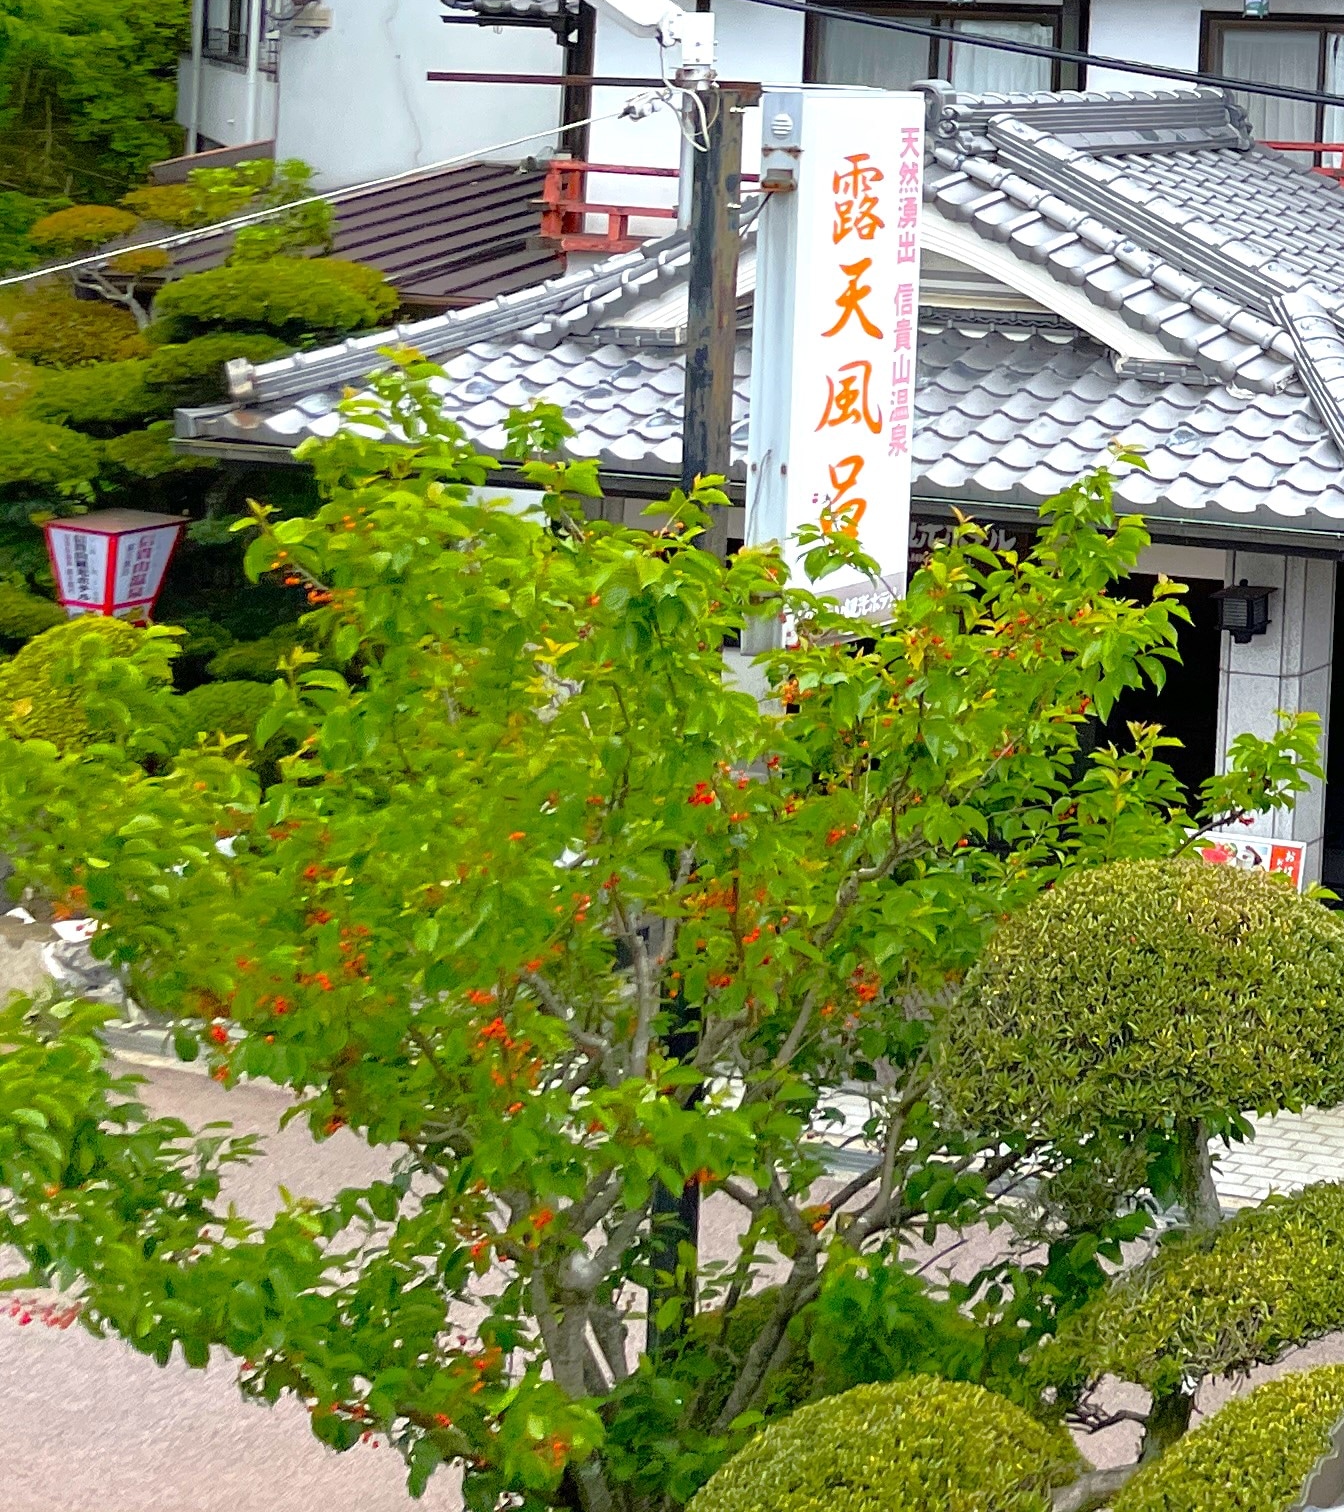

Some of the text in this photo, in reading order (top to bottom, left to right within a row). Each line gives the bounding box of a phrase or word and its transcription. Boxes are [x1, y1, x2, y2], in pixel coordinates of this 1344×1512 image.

[815, 152, 885, 540] 露天風呂
[888, 126, 920, 457] 天然湧出 信貴山温泉
